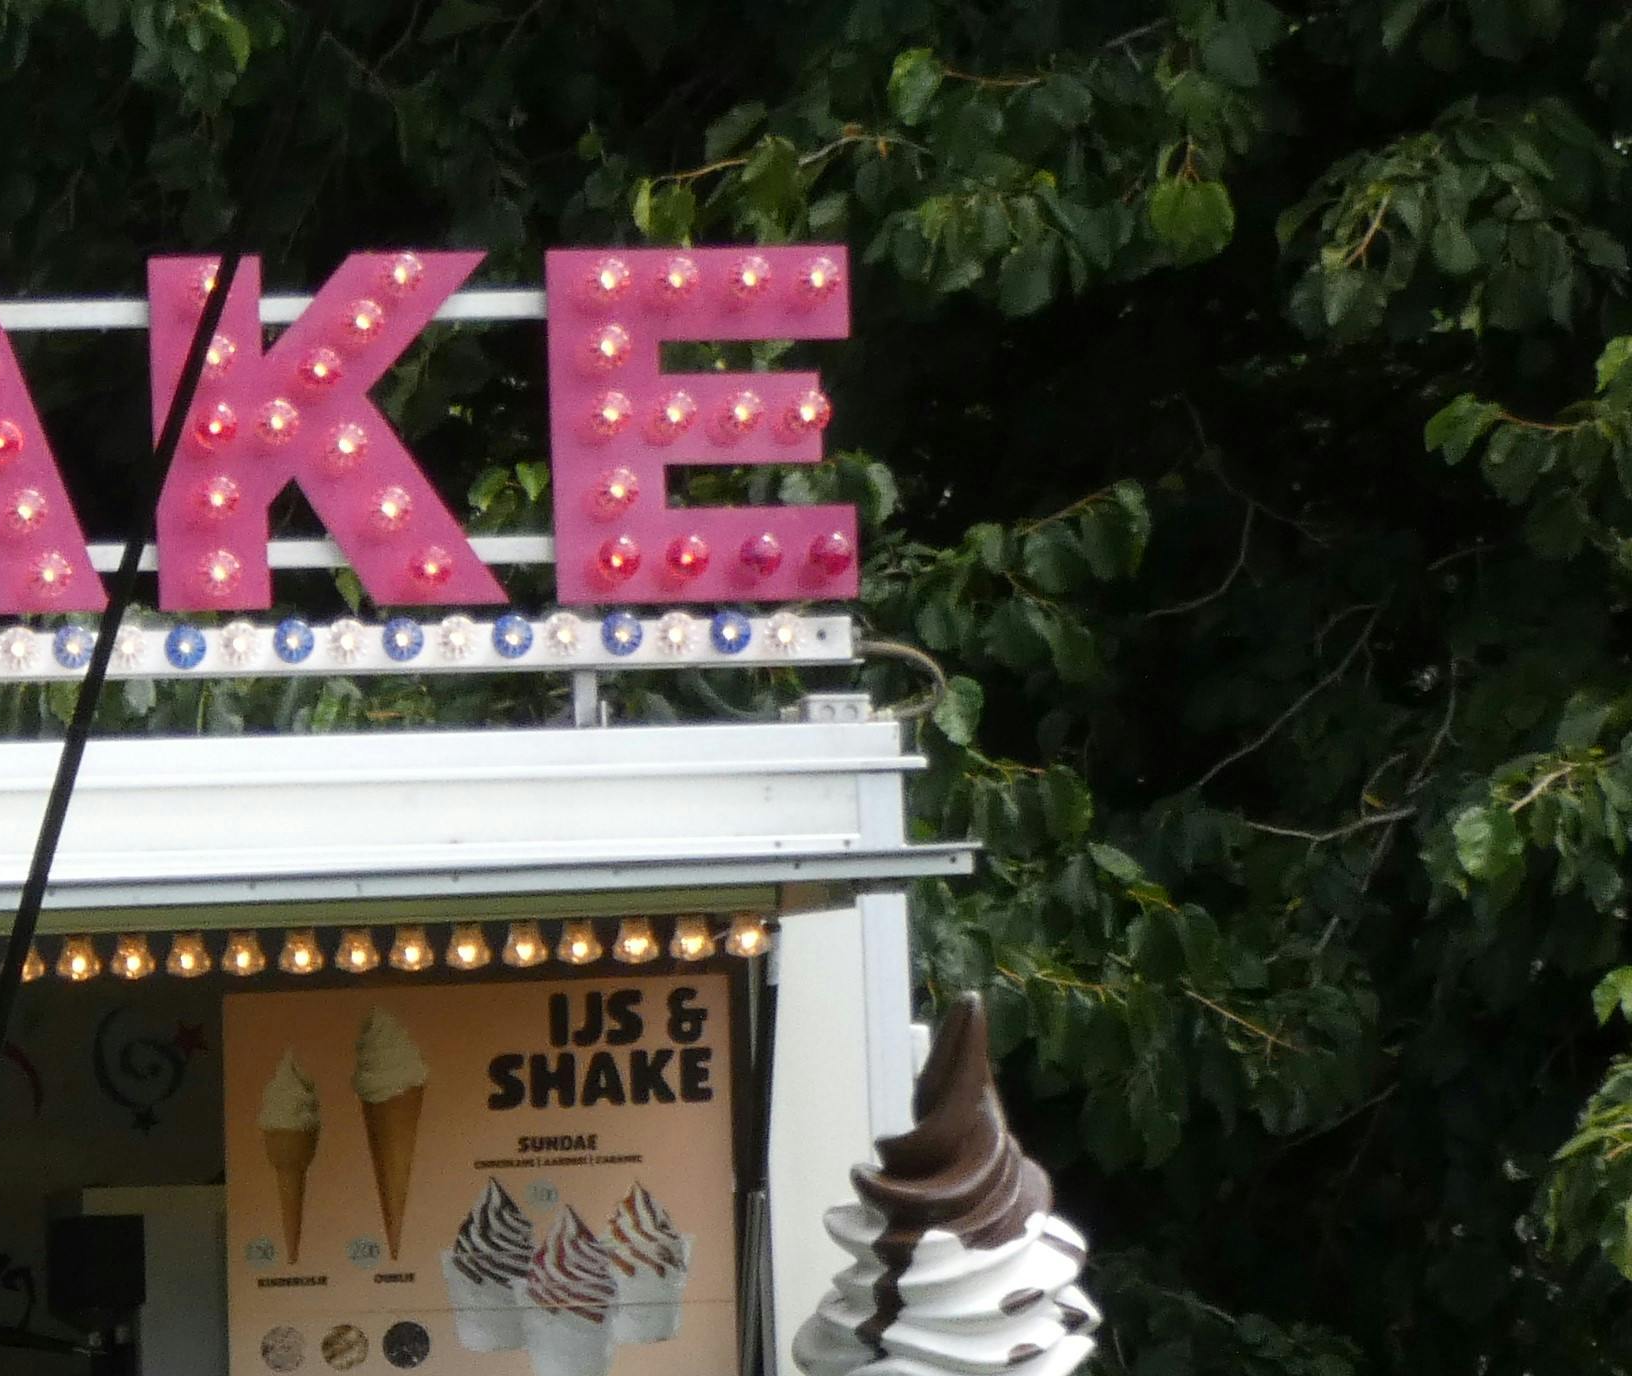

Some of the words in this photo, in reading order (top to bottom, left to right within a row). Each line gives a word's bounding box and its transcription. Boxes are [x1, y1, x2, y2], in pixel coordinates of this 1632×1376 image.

[548, 988, 644, 1048] IJS
[667, 986, 708, 1044] &
[487, 1047, 714, 1110] SHAKE
[517, 1134, 598, 1153] SUNDAE
